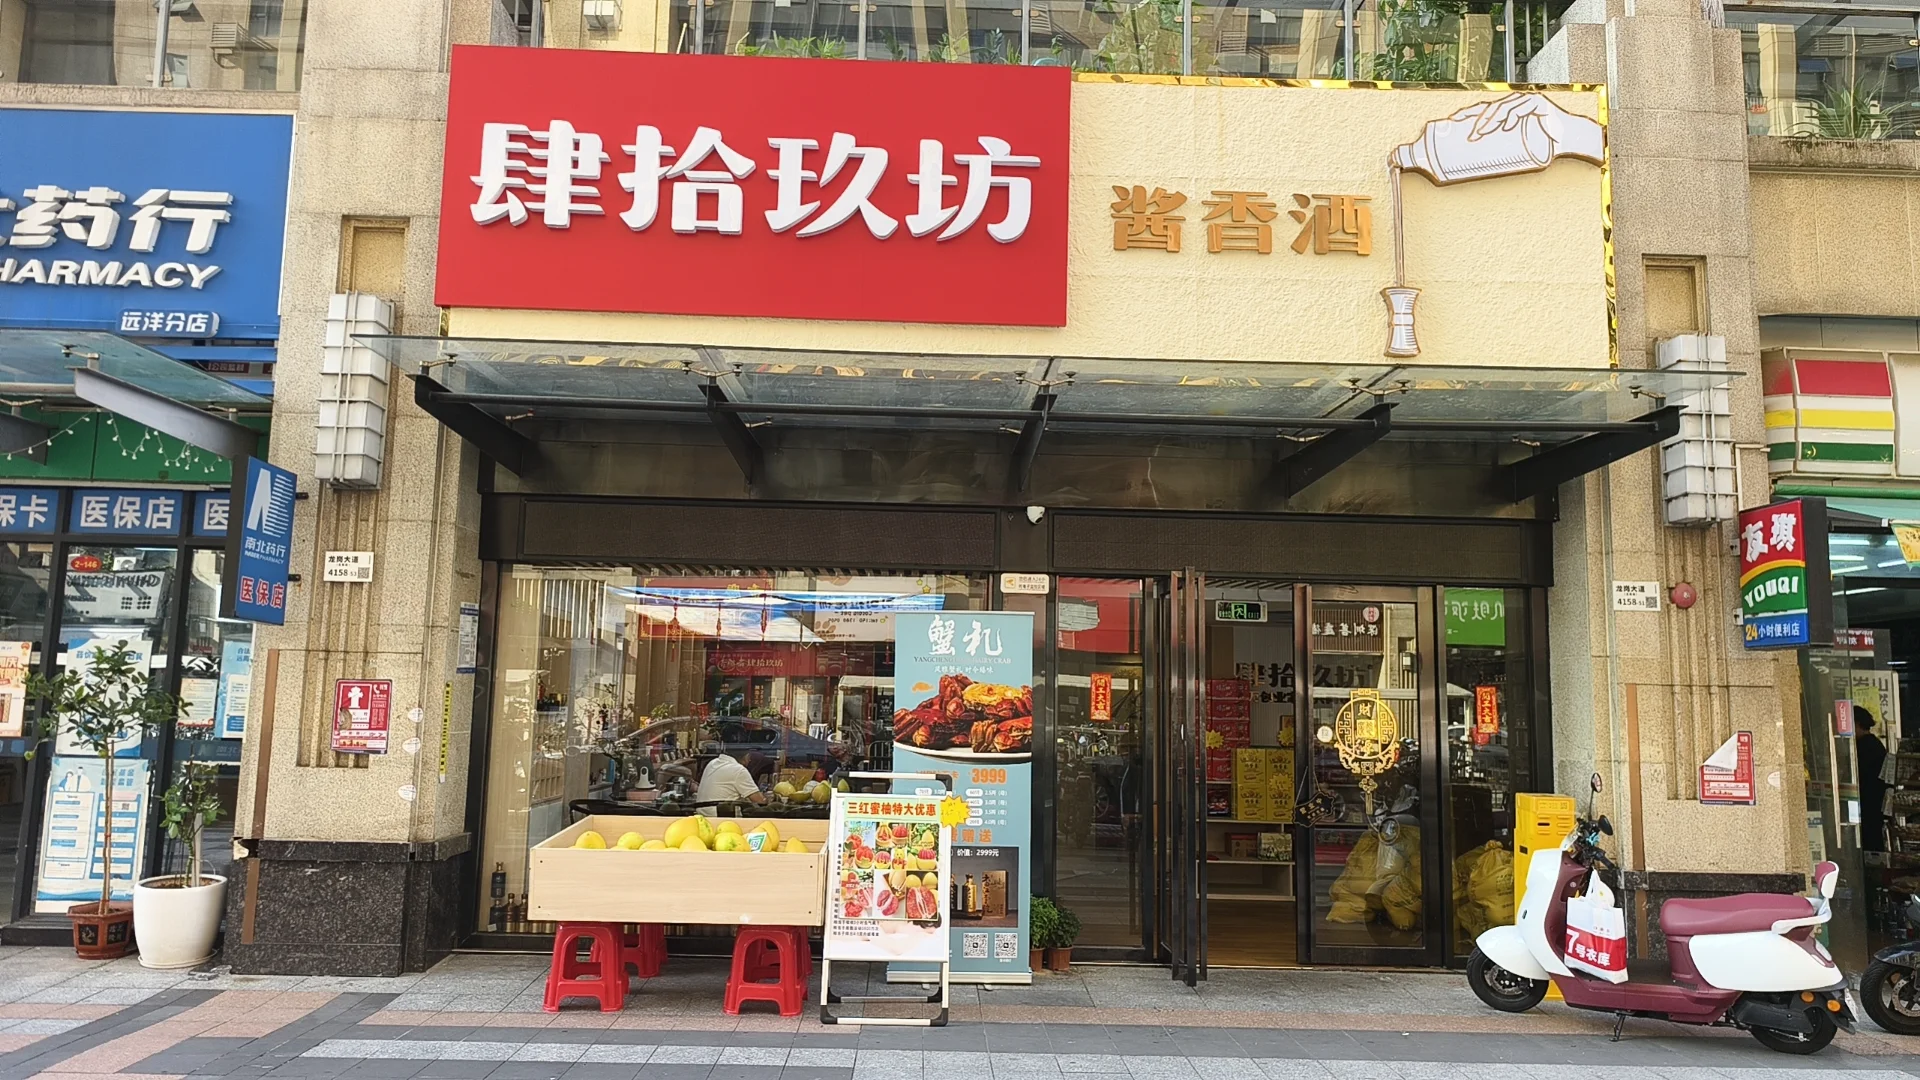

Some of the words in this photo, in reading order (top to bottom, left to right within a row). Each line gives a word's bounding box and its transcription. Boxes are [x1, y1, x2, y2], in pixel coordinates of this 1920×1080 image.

[470, 120, 1041, 243] 肆拾玖坊
[1110, 185, 1373, 255] 酱香酒
[120, 311, 209, 333] 远洋分店
[79, 495, 176, 529] 医保店
[244, 536, 287, 558] 南北药行
[1741, 512, 1797, 563] 友琪
[74, 559, 98, 569] 2-146
[239, 575, 285, 609] 医保店
[1744, 576, 1799, 608] YOUQI
[927, 614, 1003, 656] 蟹礼
[1745, 622, 1800, 641] 24小时便利店
[971, 768, 1007, 784] 3999
[847, 802, 937, 817] 三红蜜柚特大优惠
[1566, 928, 1611, 967] 7号衣库
